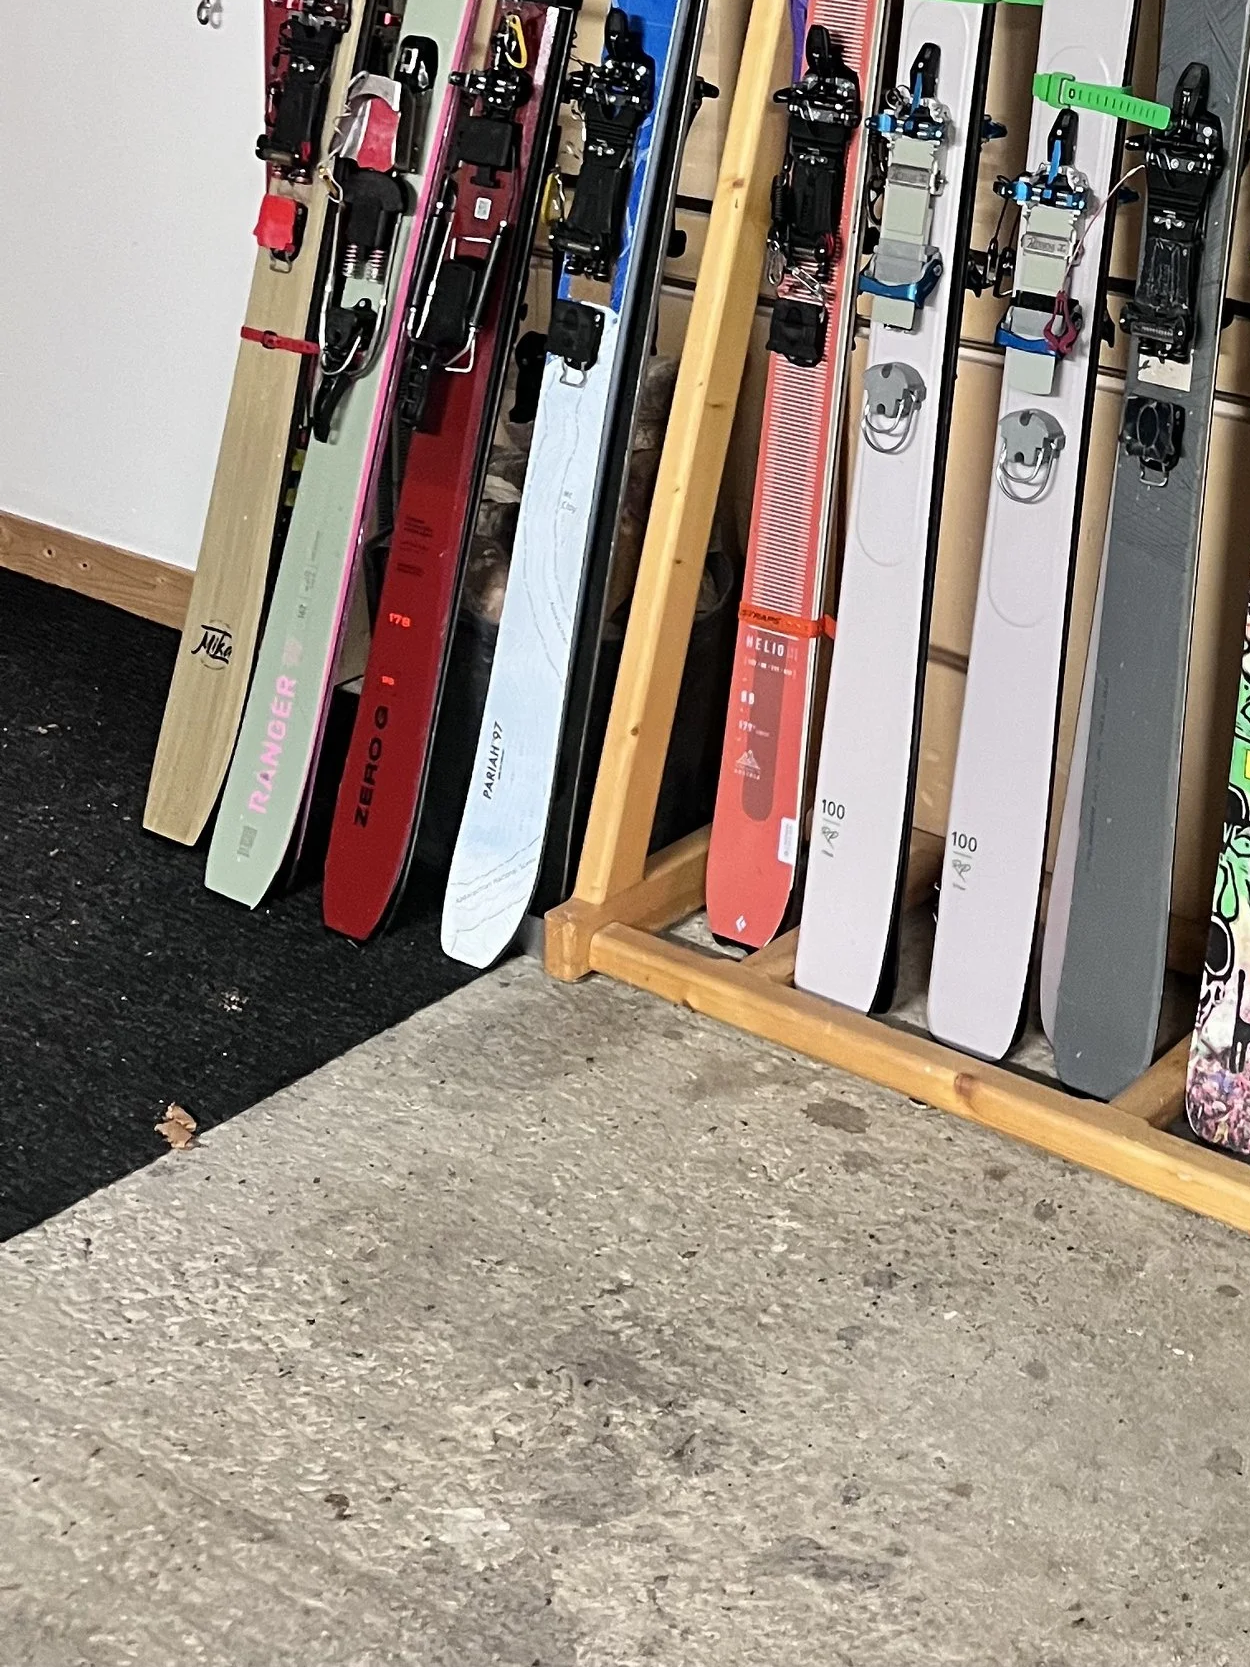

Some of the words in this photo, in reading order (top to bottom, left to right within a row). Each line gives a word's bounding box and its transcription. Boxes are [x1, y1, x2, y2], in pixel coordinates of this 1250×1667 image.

[389, 612, 411, 628] 178
[745, 635, 785, 657] HELIO
[249, 674, 297, 815] RANGER
[483, 745, 500, 801] PARIAH
[492, 720, 503, 741] 97
[353, 737, 383, 829] ZERO
[821, 799, 846, 821] 100
[951, 831, 978, 853] 100
